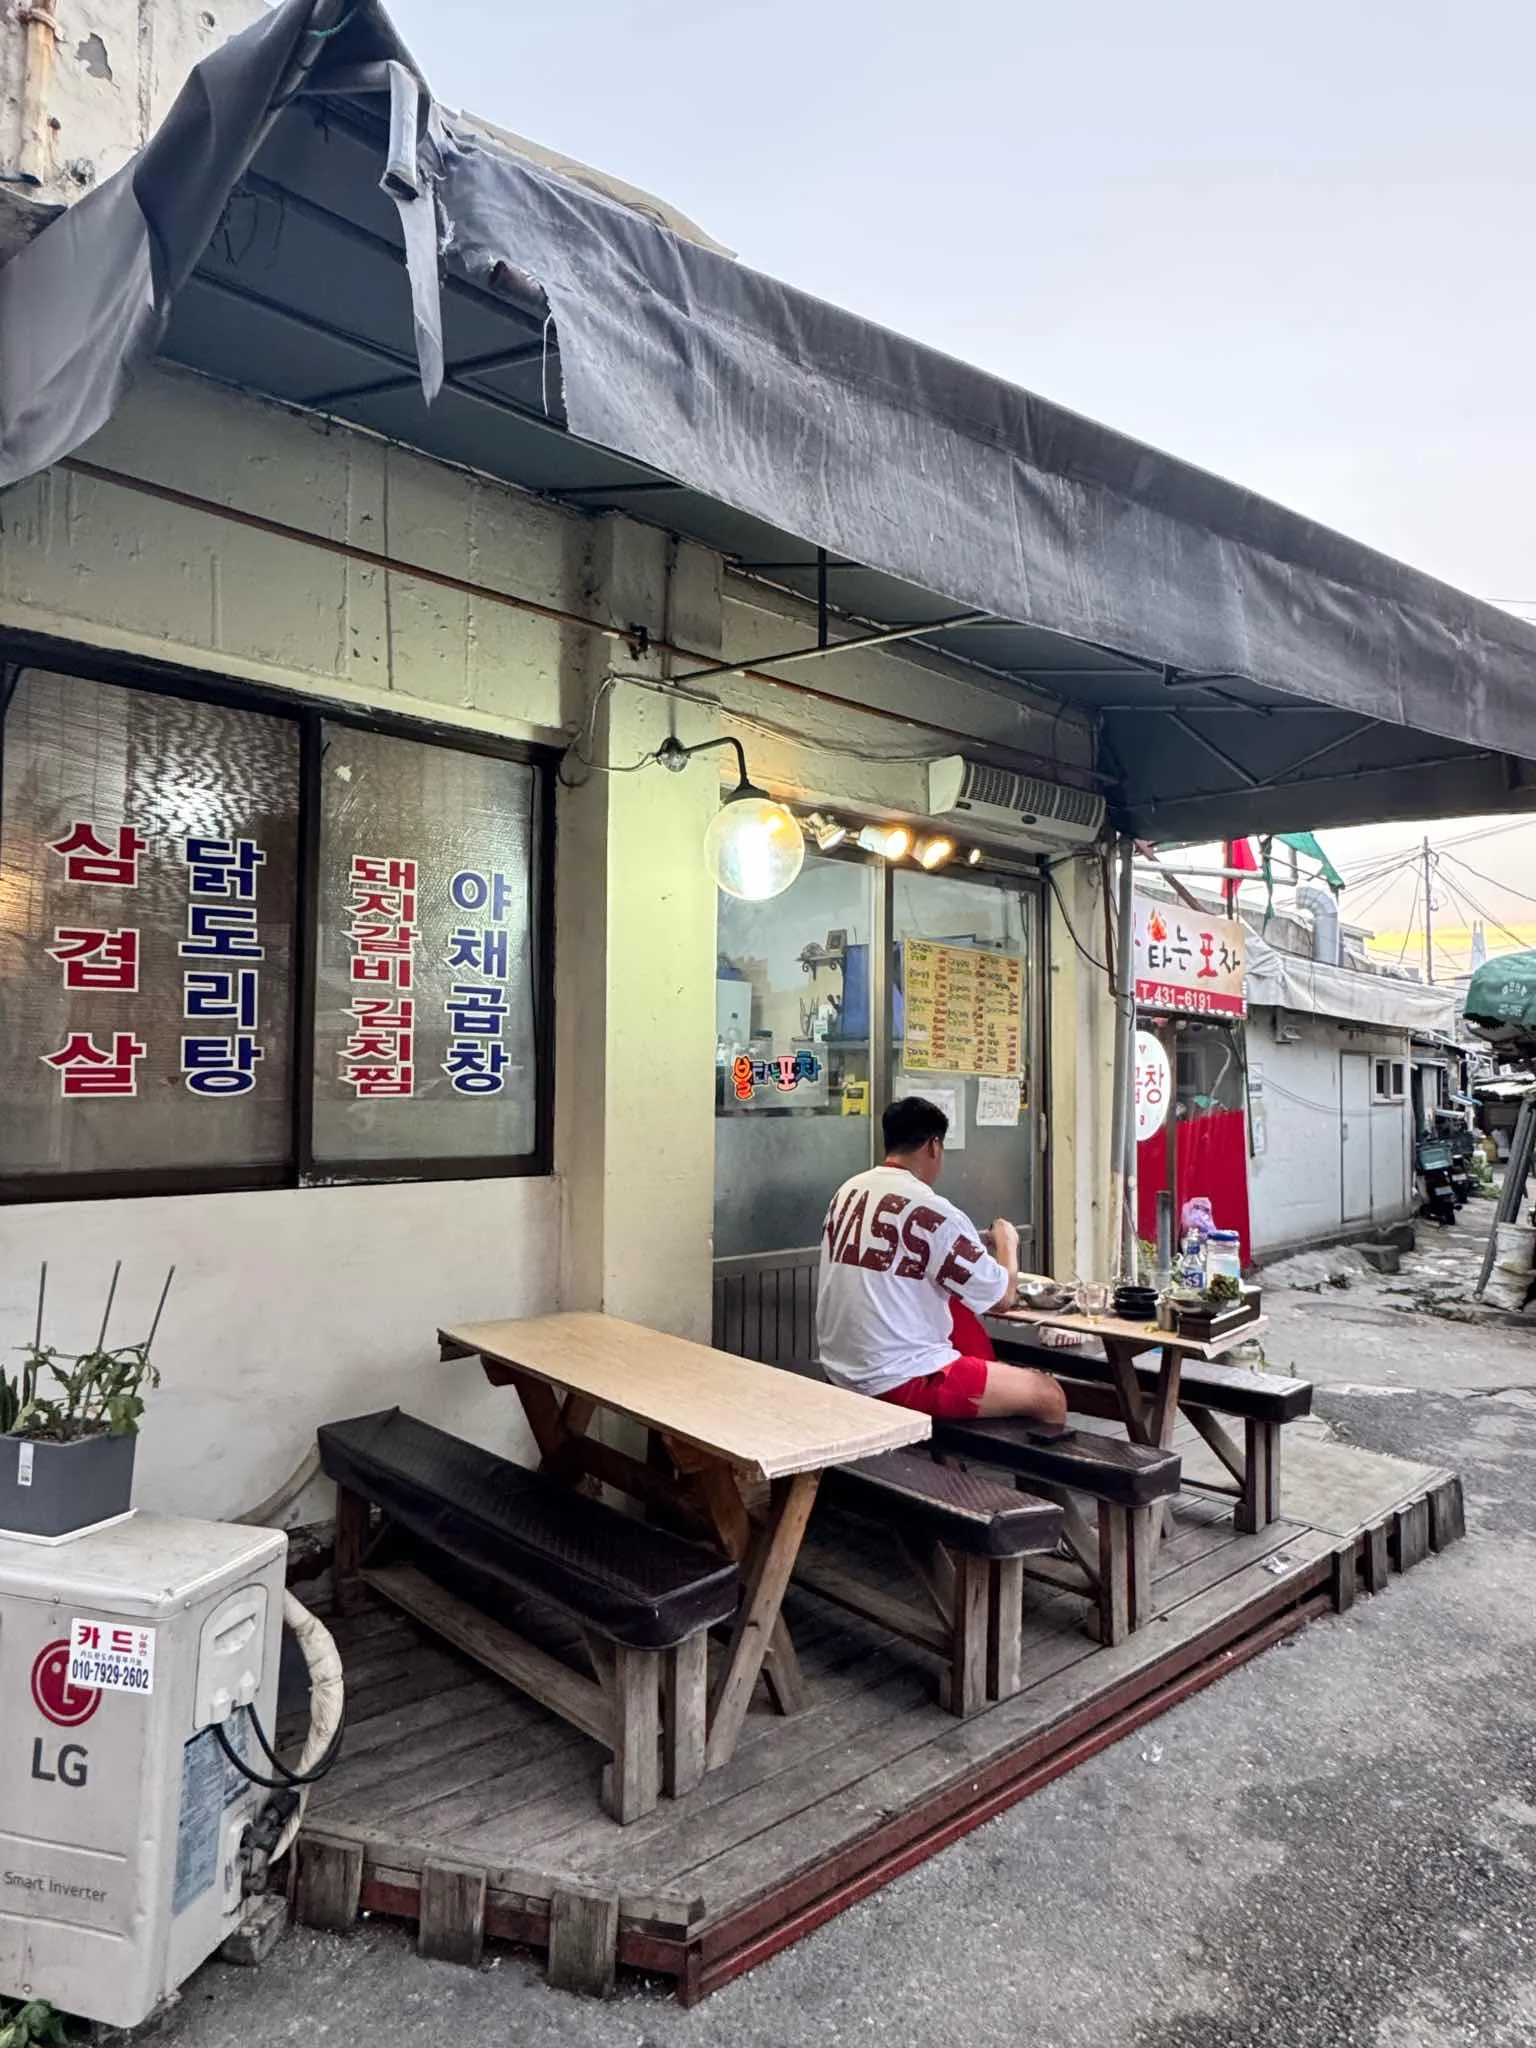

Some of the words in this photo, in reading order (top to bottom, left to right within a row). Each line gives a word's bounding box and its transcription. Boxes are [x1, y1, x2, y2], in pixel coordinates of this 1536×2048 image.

[42, 822, 149, 1097] 삼겹살
[177, 836, 266, 1096] 닭도리탕
[444, 869, 512, 1095] 야채곱창
[72, 1658, 149, 1690] 010-7929-2602
[31, 1736, 89, 1788] LG
[3, 1870, 44, 1891] Smart
[48, 1879, 107, 1903] Inverter
